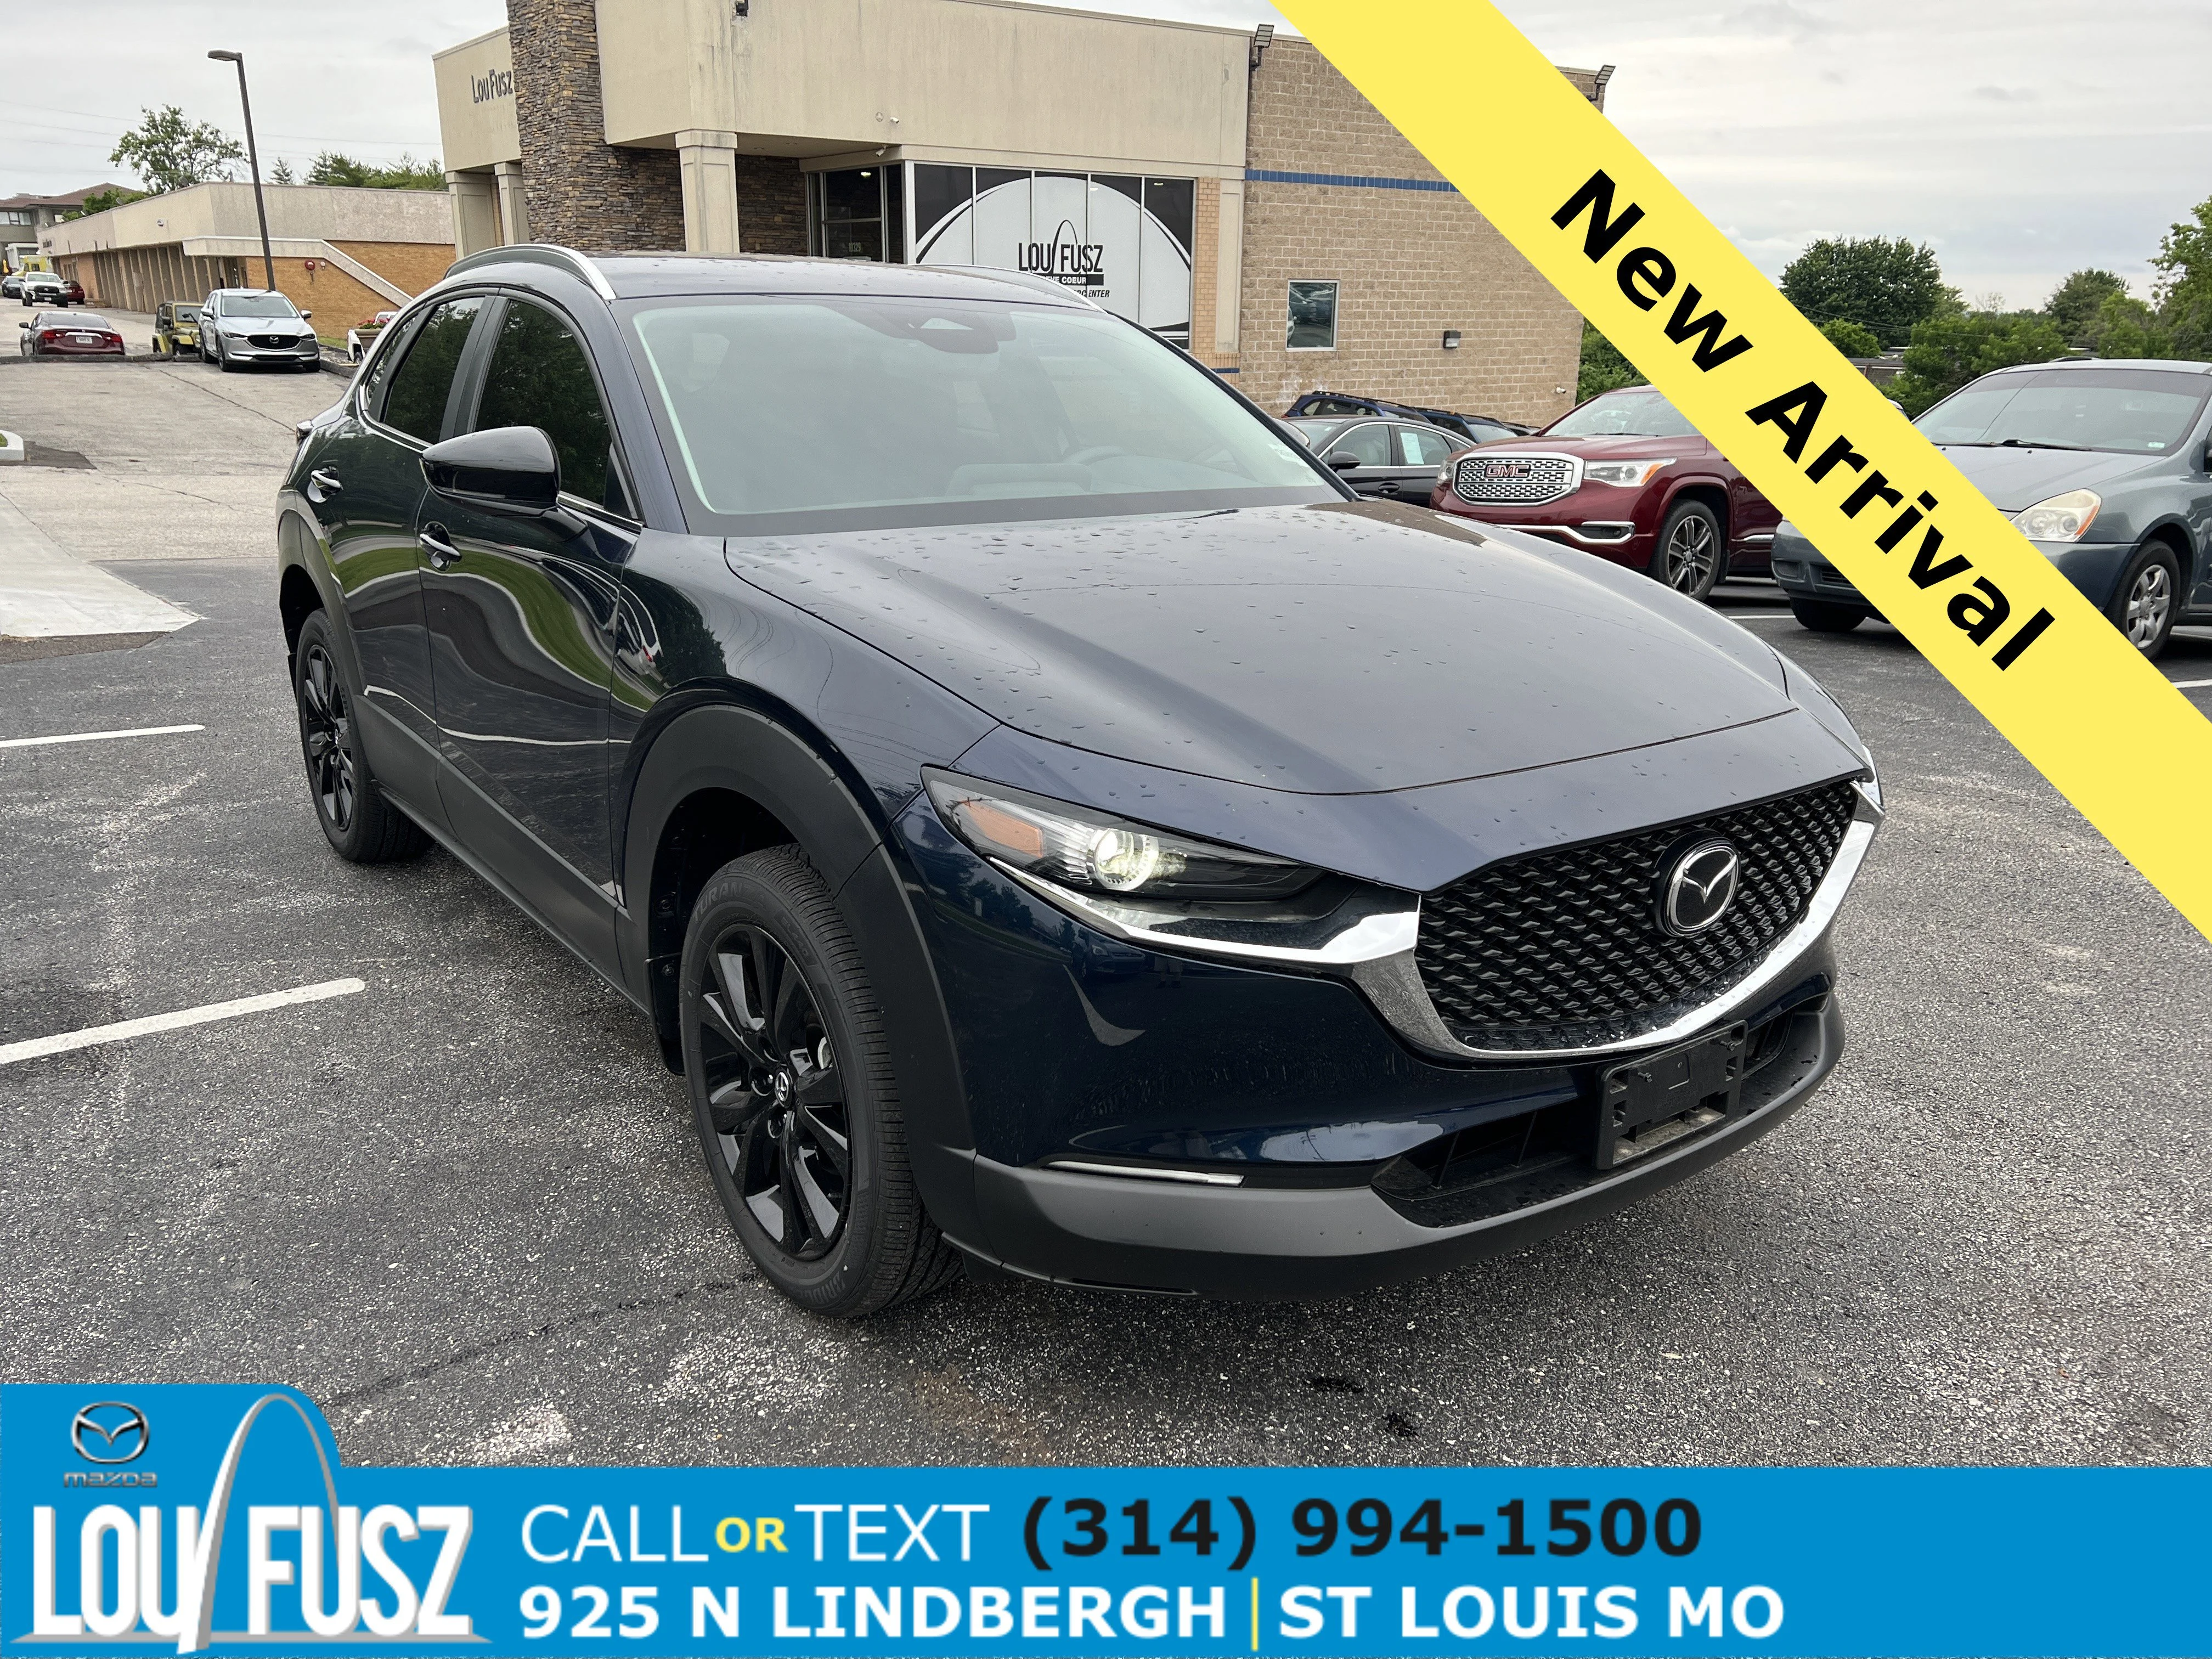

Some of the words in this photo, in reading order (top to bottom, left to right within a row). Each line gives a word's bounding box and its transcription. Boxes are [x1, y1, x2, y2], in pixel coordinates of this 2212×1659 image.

[1019, 242, 1051, 271] LOU
[1060, 244, 1103, 273] FUSZ
[1486, 465, 1530, 477] GMC
